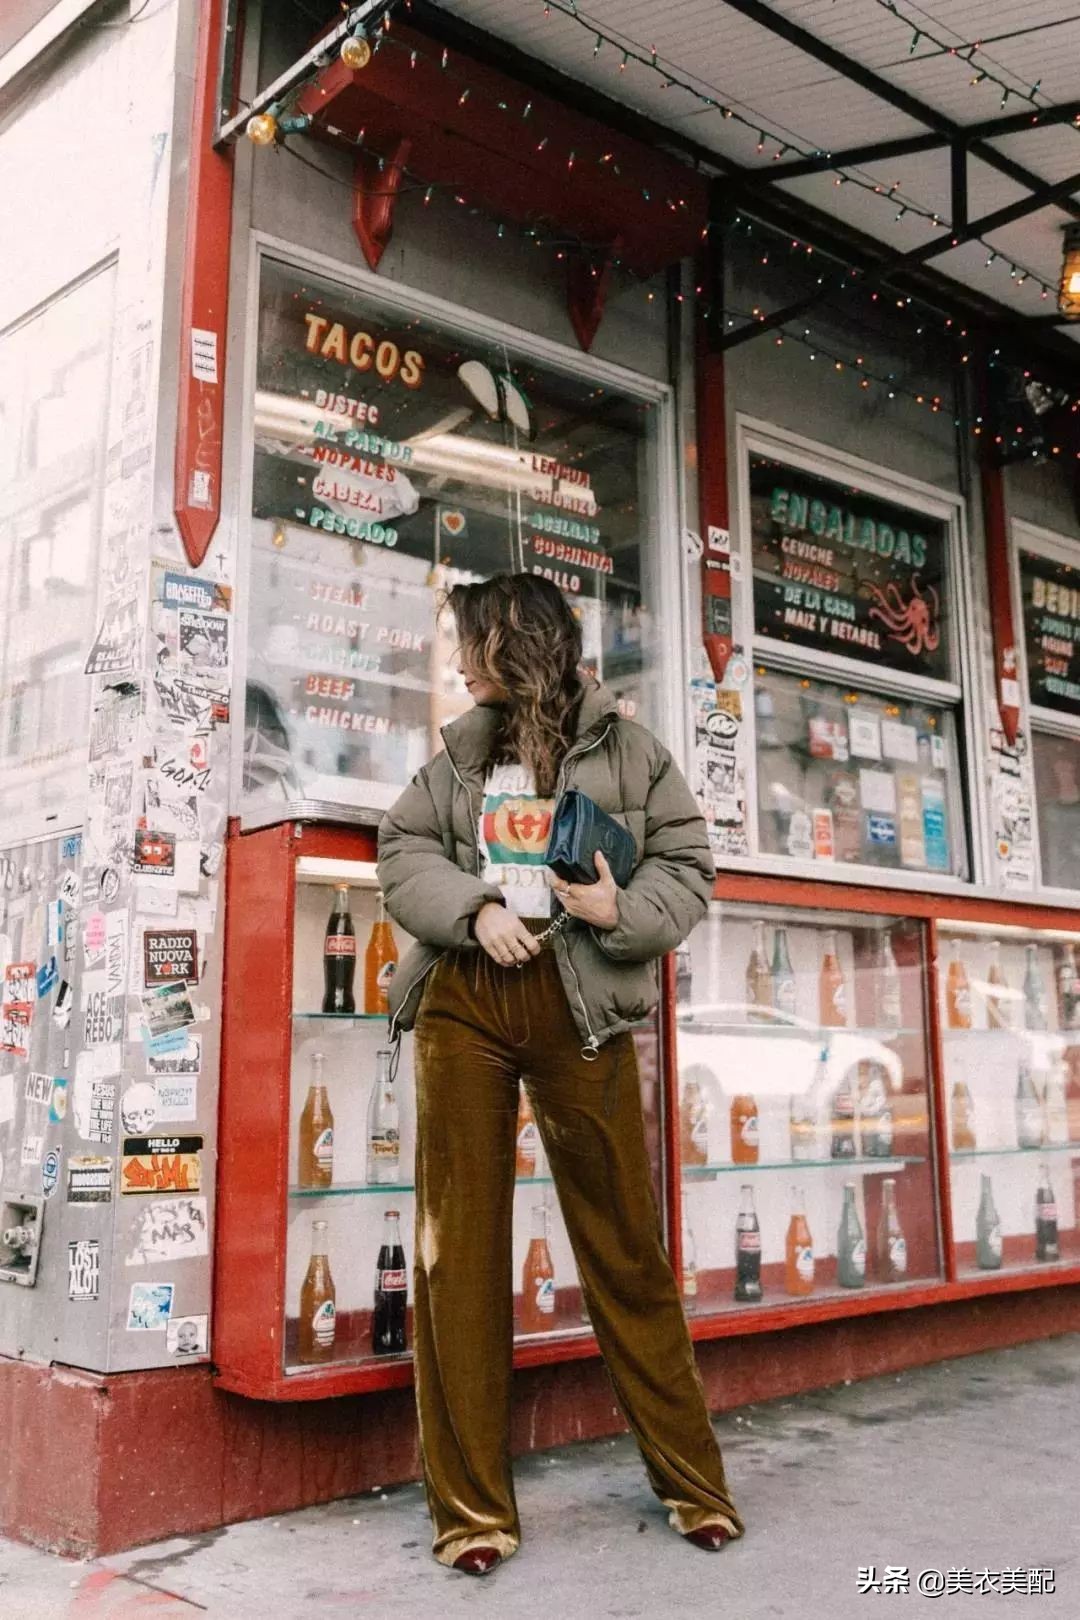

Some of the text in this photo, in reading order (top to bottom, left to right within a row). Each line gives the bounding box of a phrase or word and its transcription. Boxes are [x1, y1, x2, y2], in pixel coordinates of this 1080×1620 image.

[304, 313, 426, 389] TACOS
[314, 388, 380, 424] BISTEC
[313, 419, 414, 463] AL PASTOR
[312, 446, 397, 483] NOPALES
[312, 477, 384, 515] CABEZA
[309, 508, 399, 547] PESCADO
[770, 487, 927, 568] ENSALADAS
[781, 537, 834, 566] CEVICHE
[533, 564, 581, 592] POLLO
[309, 581, 368, 610] STEAK
[784, 586, 856, 621] DE LA CASA
[1033, 576, 1080, 619] BEBI
[306, 611, 427, 652] ROAST PORK
[784, 608, 881, 650] MAIZ Y BETABEL
[304, 672, 355, 701] BEEF
[305, 706, 392, 736] CHICKEN
[149, 936, 193, 950] RADIO
[149, 949, 194, 963] NUOVA
[87, 991, 107, 1017] ACE
[85, 1016, 113, 1043] REBO
[27, 1073, 50, 1101] NEW
[148, 1138, 180, 1148] HELLO
[68, 1247, 99, 1271] LOST
[68, 1268, 99, 1294] ALOT
